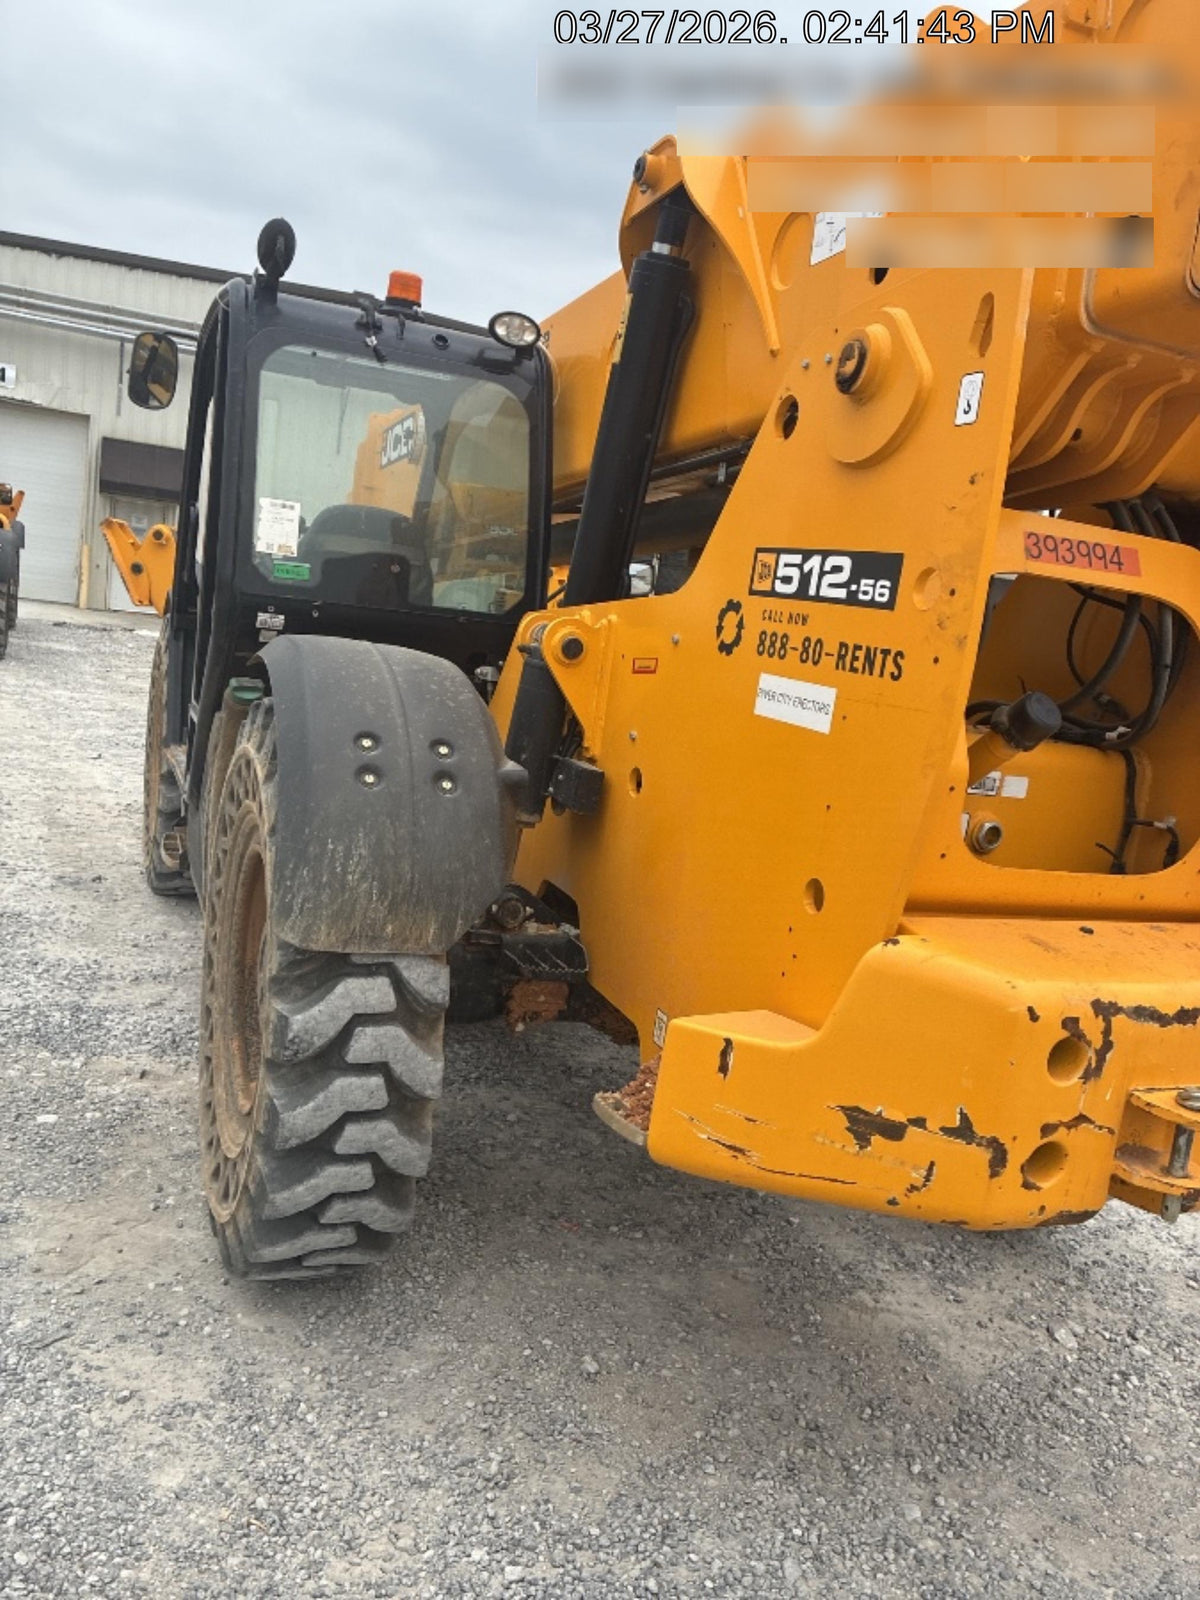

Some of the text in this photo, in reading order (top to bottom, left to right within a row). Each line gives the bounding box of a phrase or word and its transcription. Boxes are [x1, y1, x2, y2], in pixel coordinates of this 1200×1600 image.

[1026, 532, 1124, 571] 393994
[762, 609, 810, 626] CALL NOW
[757, 630, 905, 681] 888-80-RENTS
